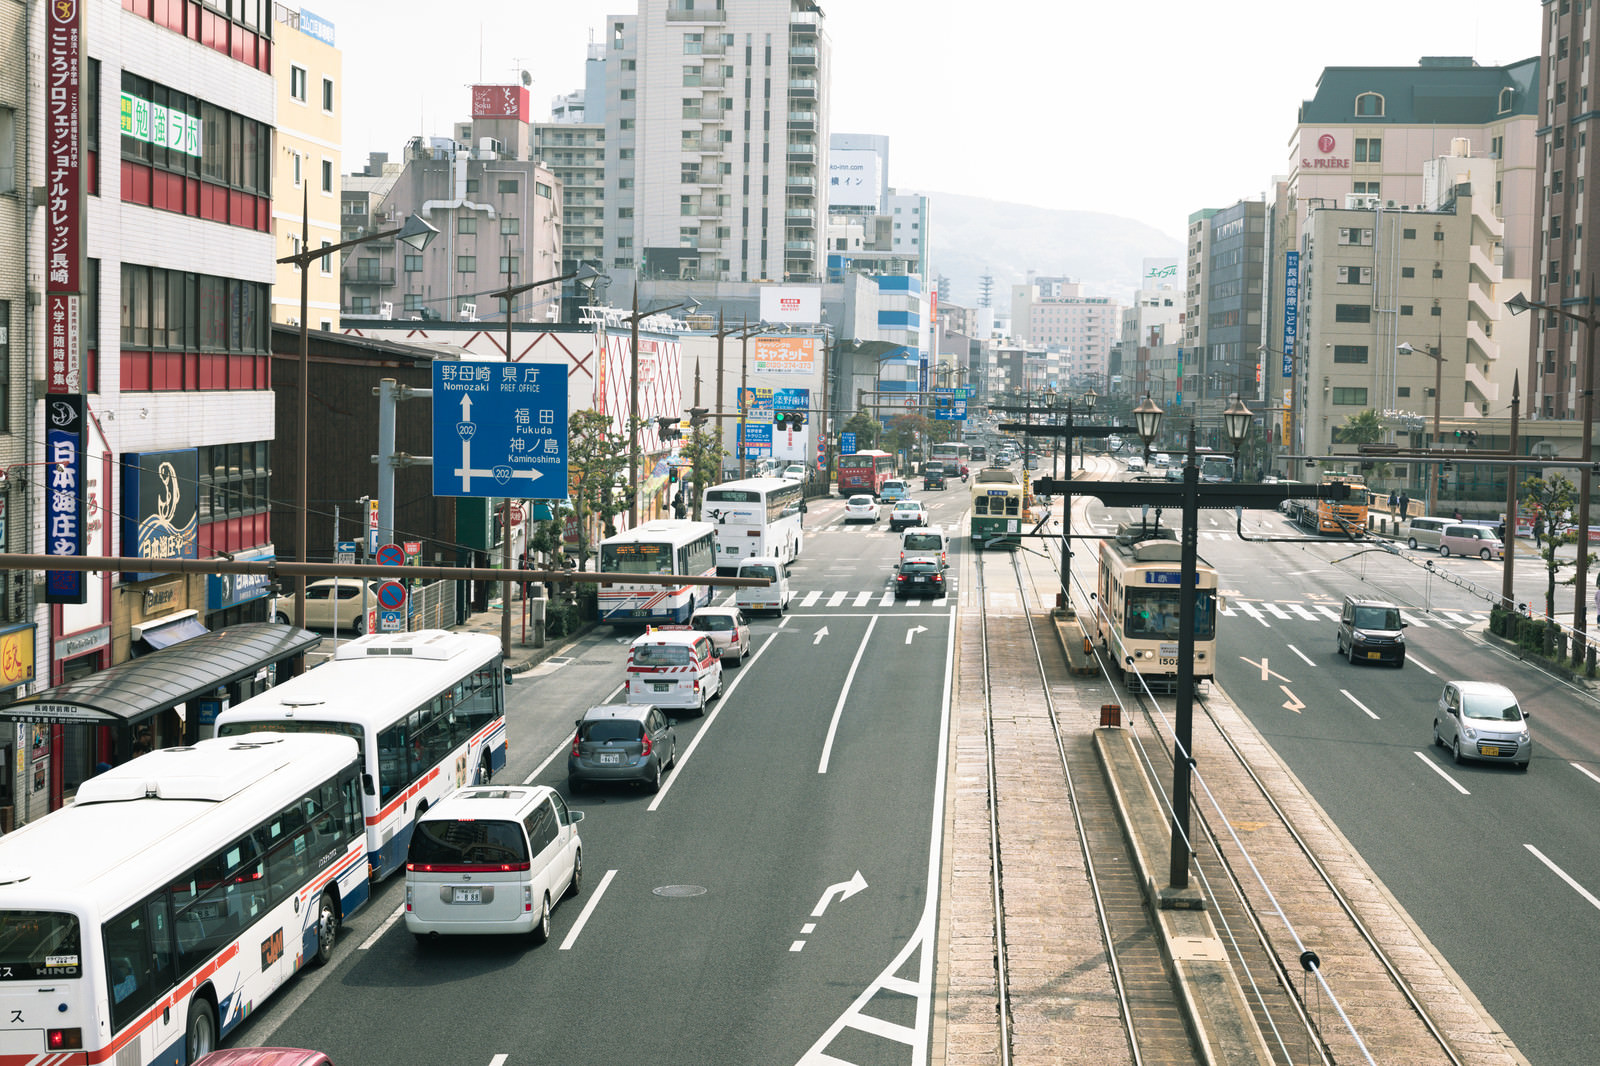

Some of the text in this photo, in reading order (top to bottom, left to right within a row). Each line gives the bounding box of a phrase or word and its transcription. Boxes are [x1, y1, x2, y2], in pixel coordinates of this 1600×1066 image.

[136, 100, 197, 151] 勉強ラボ
[50, 27, 69, 285] こころプロフェッショナルカレッジ長崎
[1314, 156, 1350, 168] PRIÈRE
[1144, 264, 1177, 279] エイブル
[53, 298, 65, 385] 入学生随時募集
[757, 348, 809, 360] キャネット
[441, 365, 541, 383] 野母崎 県庁
[443, 382, 490, 392] Nomozaki
[514, 408, 554, 425] 福田
[459, 425, 473, 434] 202
[516, 425, 553, 435] Fukuda
[509, 437, 559, 455] 神ノ島
[508, 454, 561, 464] Kaminoshima
[495, 469, 510, 478] 202
[52, 440, 77, 556] 日本海庄や
[34, 704, 78, 713] 長崎駅前南口
[0, 967, 14, 977] ス
[36, 966, 77, 976] HINO
[10, 1009, 25, 1023] ス
